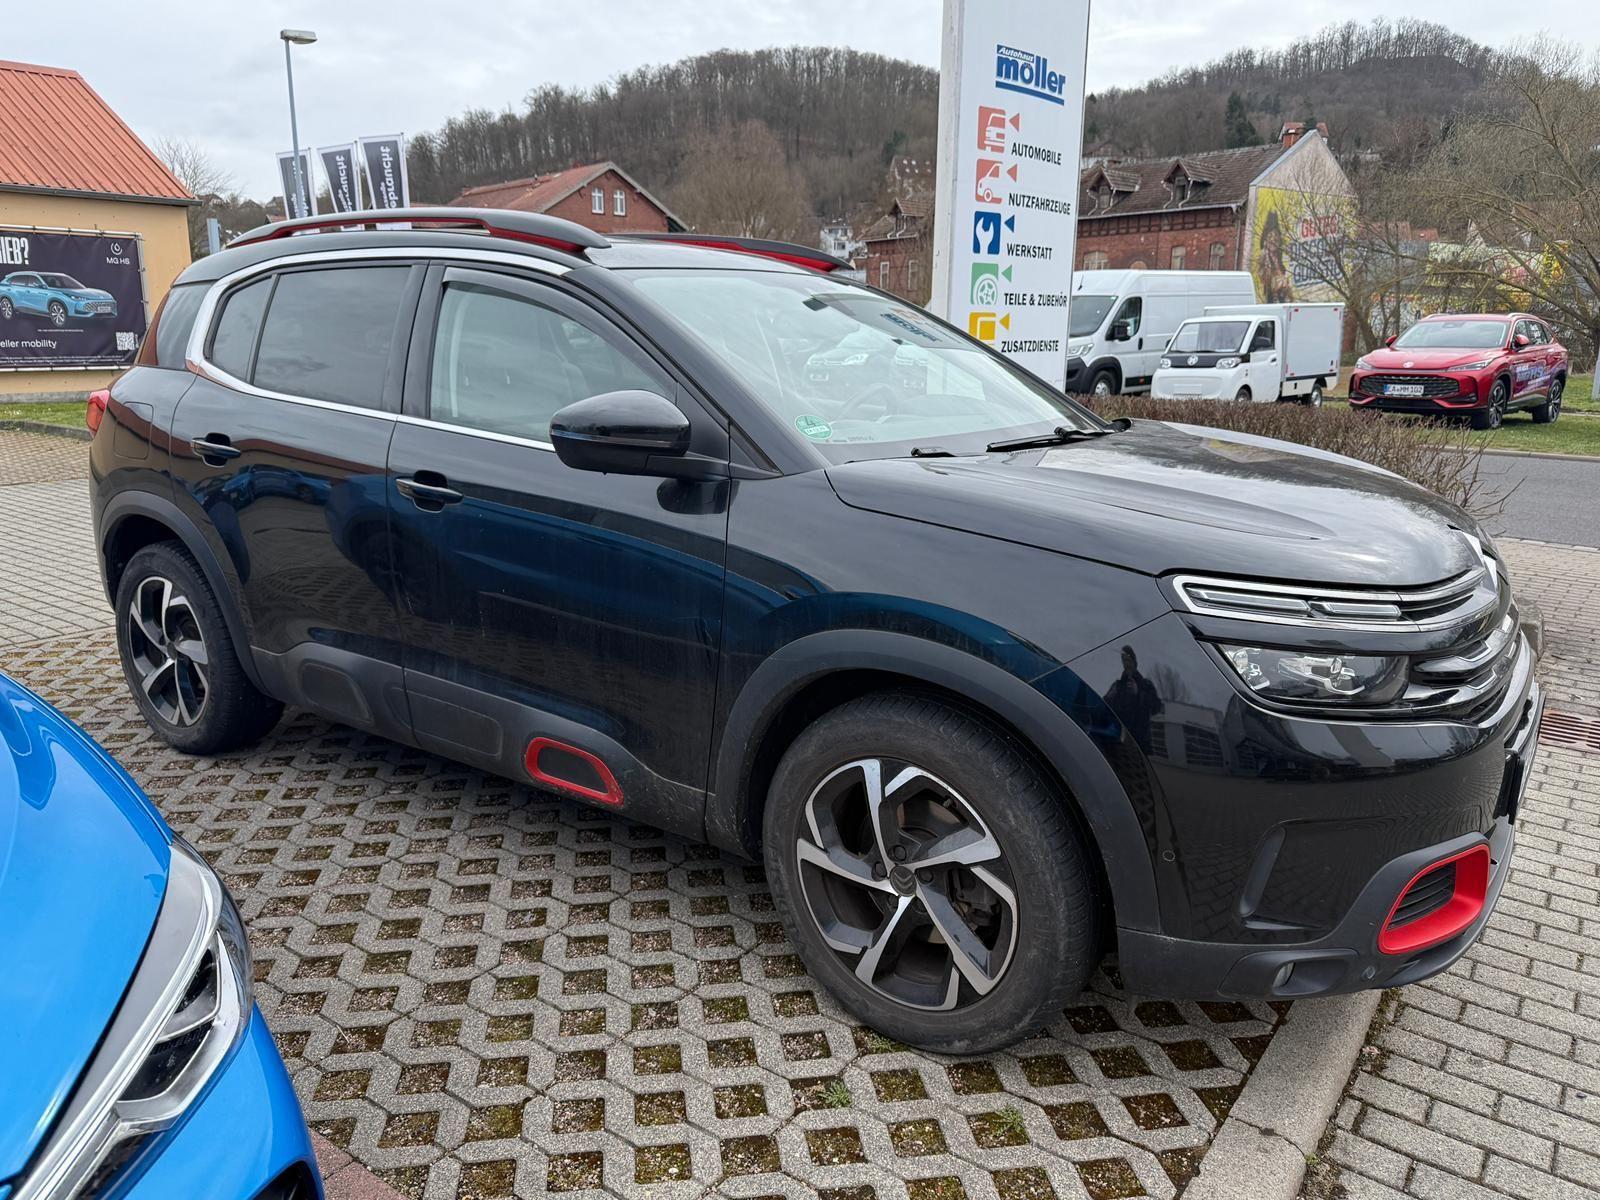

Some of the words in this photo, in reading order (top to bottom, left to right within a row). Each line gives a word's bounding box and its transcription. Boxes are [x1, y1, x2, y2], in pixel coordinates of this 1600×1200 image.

[999, 46, 1034, 62] Autohaus
[1011, 142, 1062, 166] AUTOMOBILE
[1008, 192, 1071, 216] NUTZFAHRZEUGE
[0, 236, 29, 265] IEB?
[1006, 243, 1053, 260] WERKSTATT
[119, 257, 130, 265] HS
[1004, 293, 1027, 306] TEILE
[1029, 293, 1035, 306] &
[1037, 291, 1067, 307] ZUBEHÖR
[21, 339, 57, 349] mobility
[1001, 340, 1059, 353] ZUSATZDIENSTE
